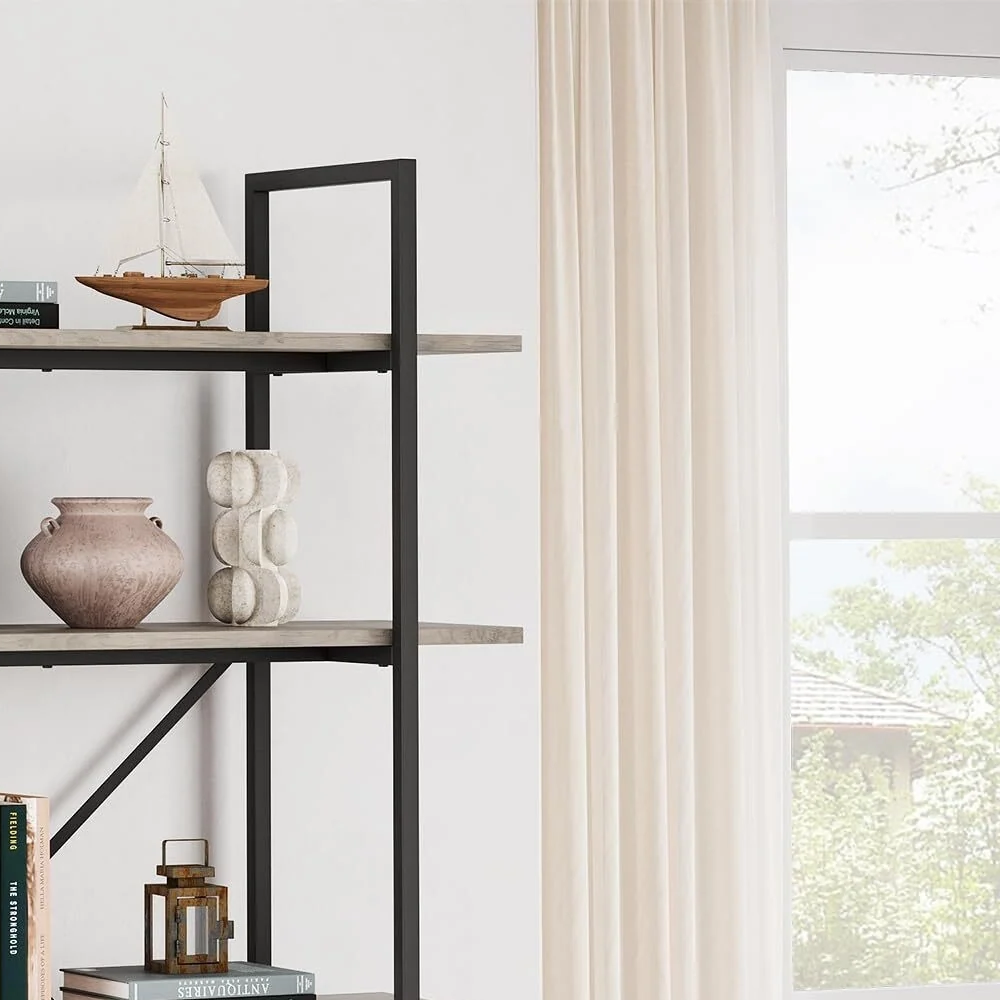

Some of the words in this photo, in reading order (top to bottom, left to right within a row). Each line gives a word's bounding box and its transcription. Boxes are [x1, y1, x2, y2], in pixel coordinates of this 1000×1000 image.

[16, 307, 40, 316] Virginia
[22, 317, 40, 325] Detail
[9, 812, 17, 850] FIELDING
[10, 882, 18, 897] THE
[10, 900, 18, 955] STRONGHOLD
[177, 983, 270, 998] ANTIQUAIRES
